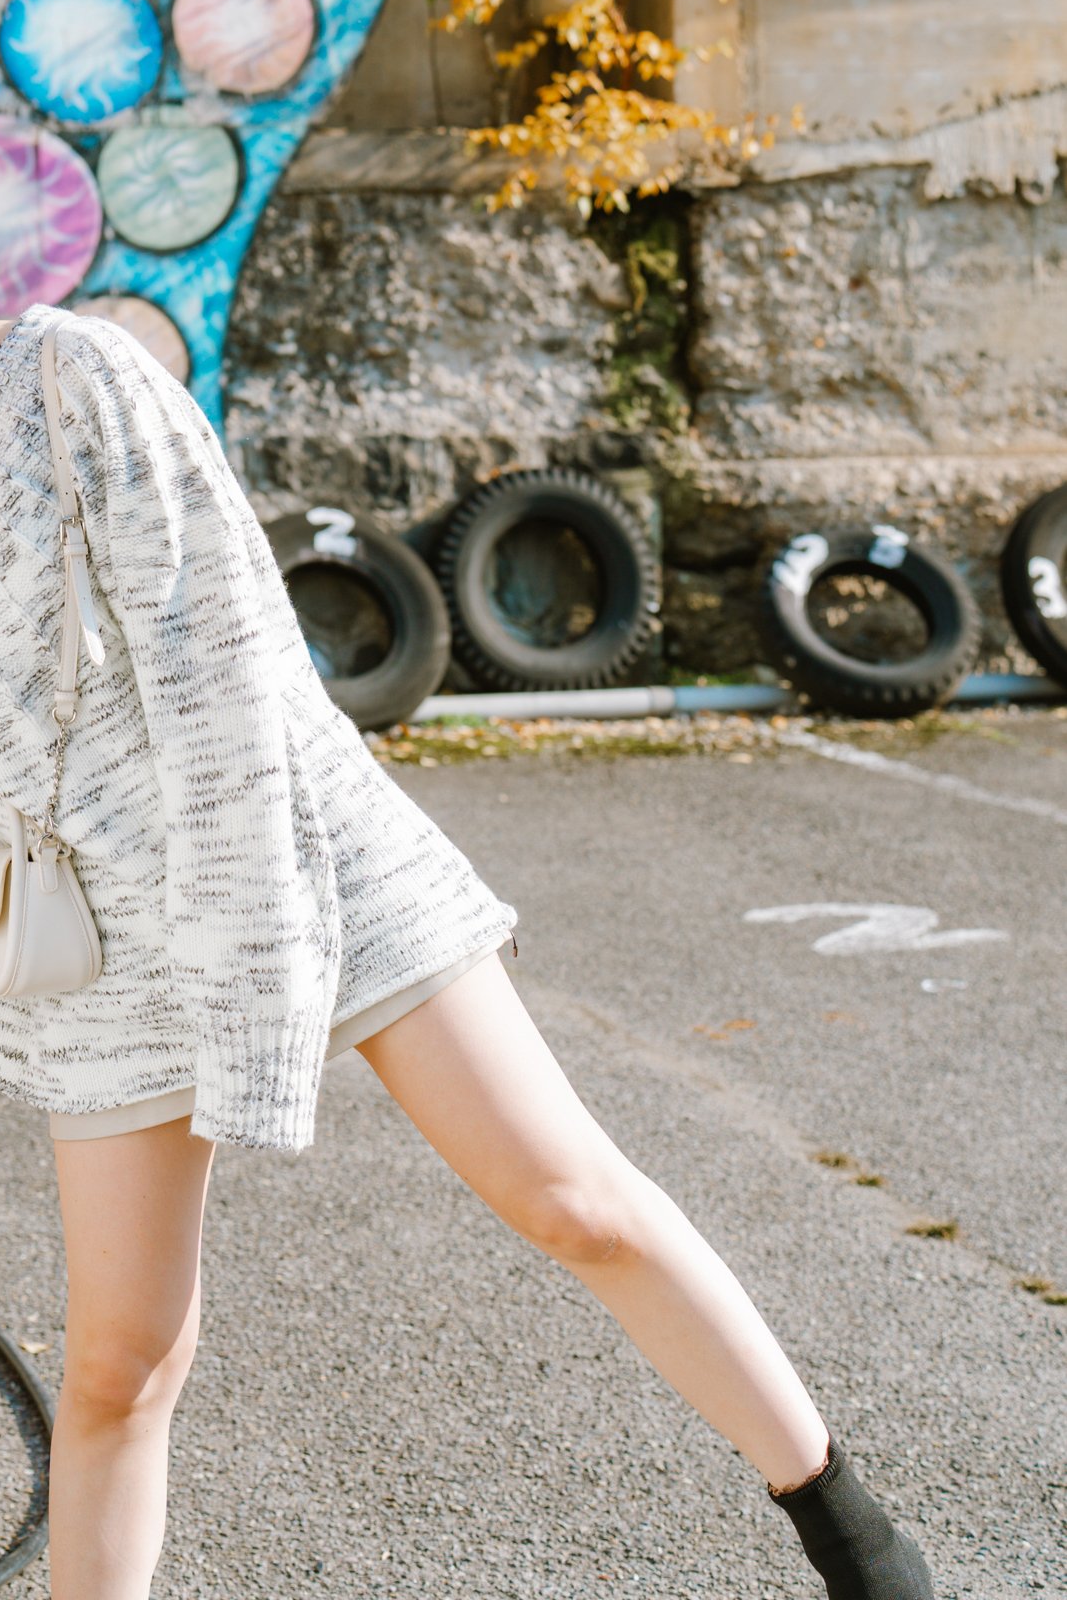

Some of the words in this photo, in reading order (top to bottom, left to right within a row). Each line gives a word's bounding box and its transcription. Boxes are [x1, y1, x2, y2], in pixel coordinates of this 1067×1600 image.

[305, 506, 356, 557] 2
[1028, 556, 1067, 619] 3
[742, 902, 1011, 957] 2
